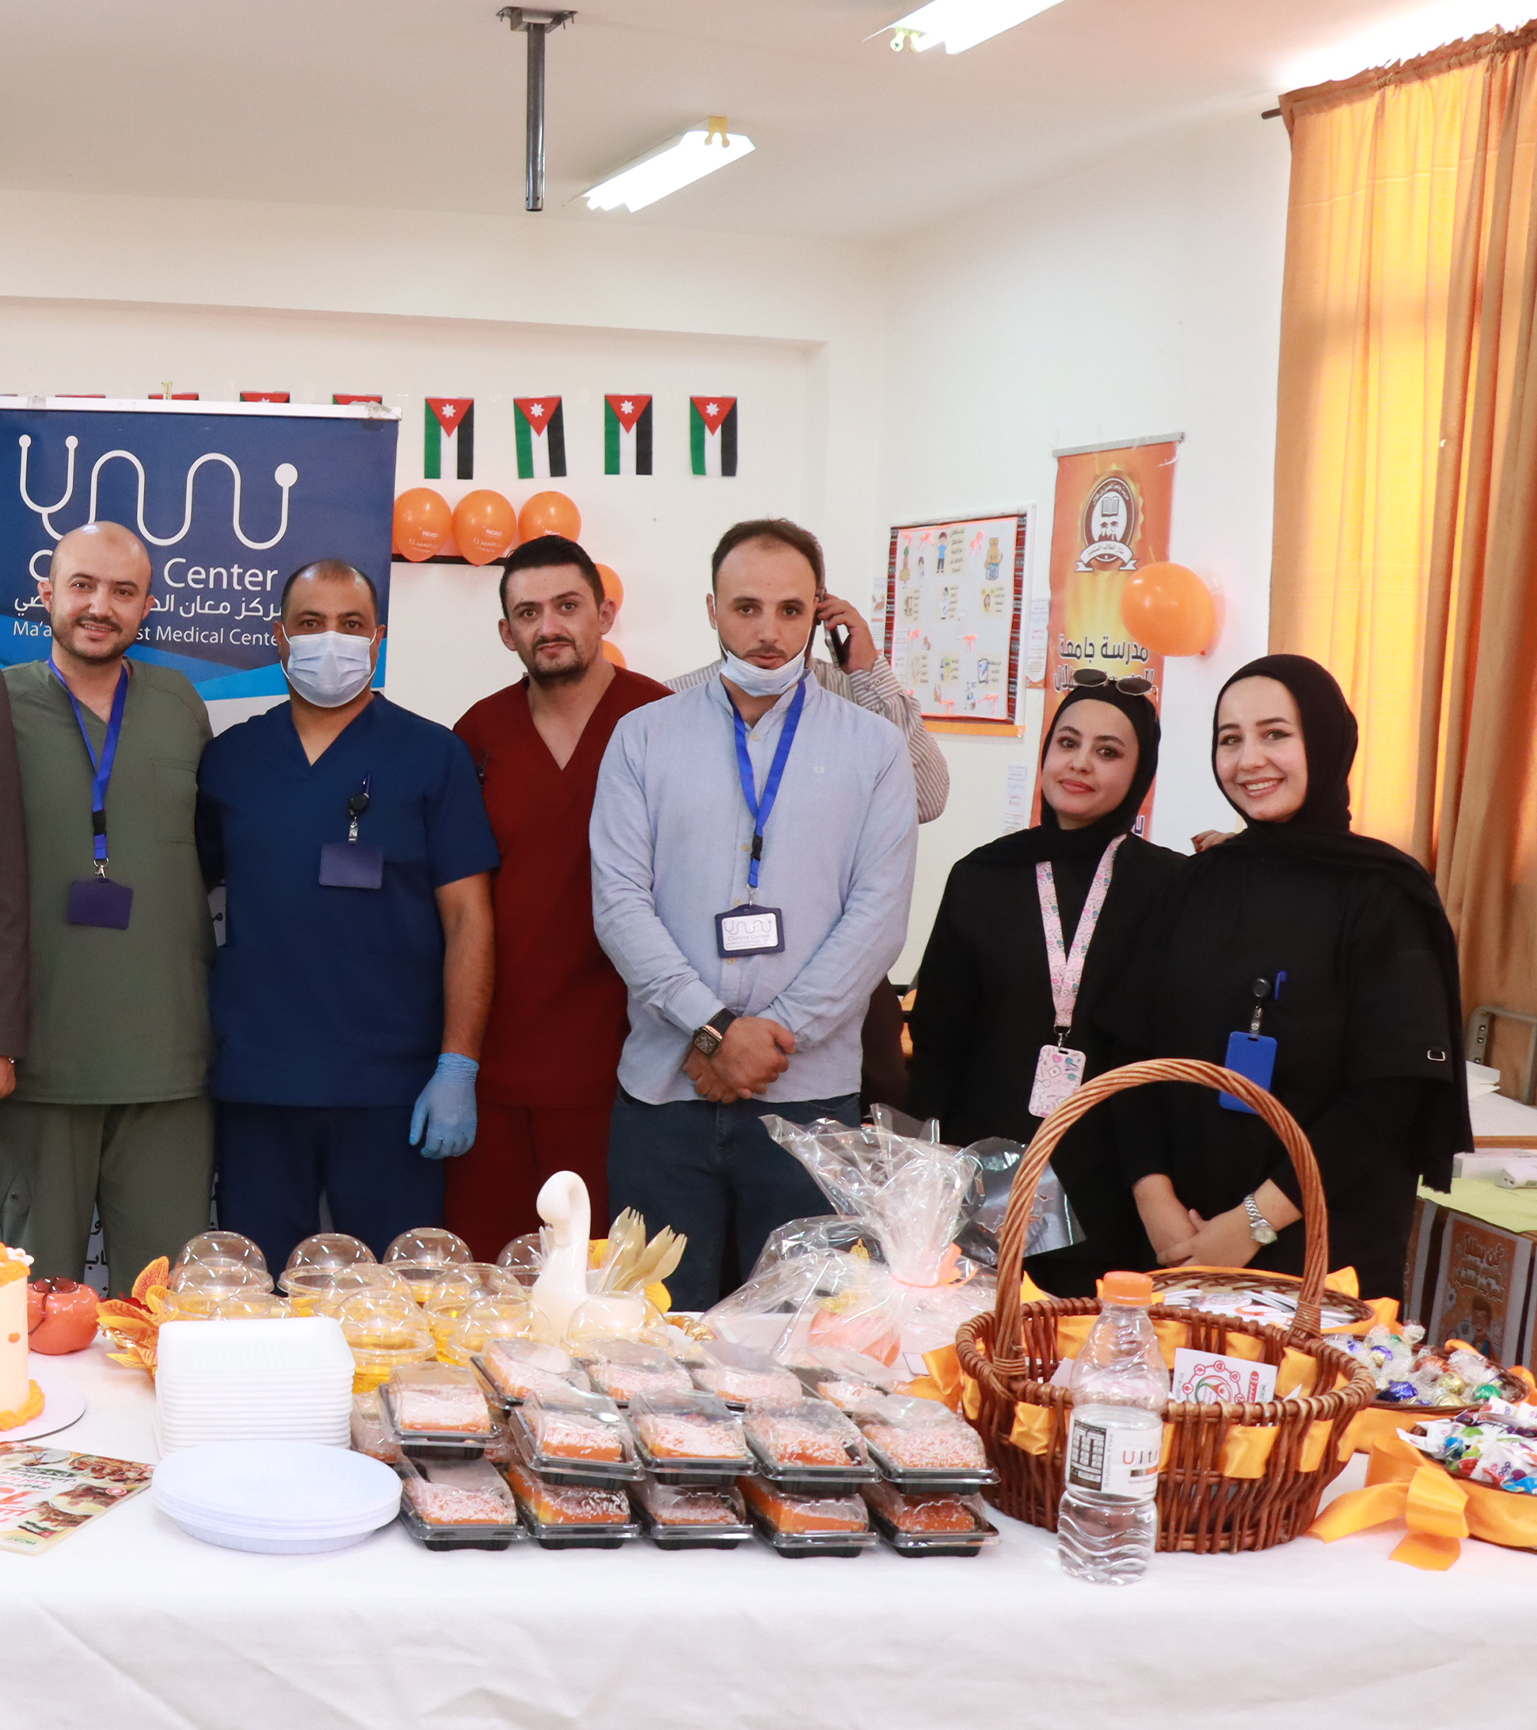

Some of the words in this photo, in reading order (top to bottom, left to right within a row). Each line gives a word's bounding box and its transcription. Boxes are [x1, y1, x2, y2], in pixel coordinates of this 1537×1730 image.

[163, 557, 279, 591] Center
[178, 598, 231, 618] معان
[155, 625, 225, 644] Medical
[229, 628, 279, 647] Cente
[1058, 633, 1096, 664] جامعة
[1100, 635, 1150, 666] مدرسة
